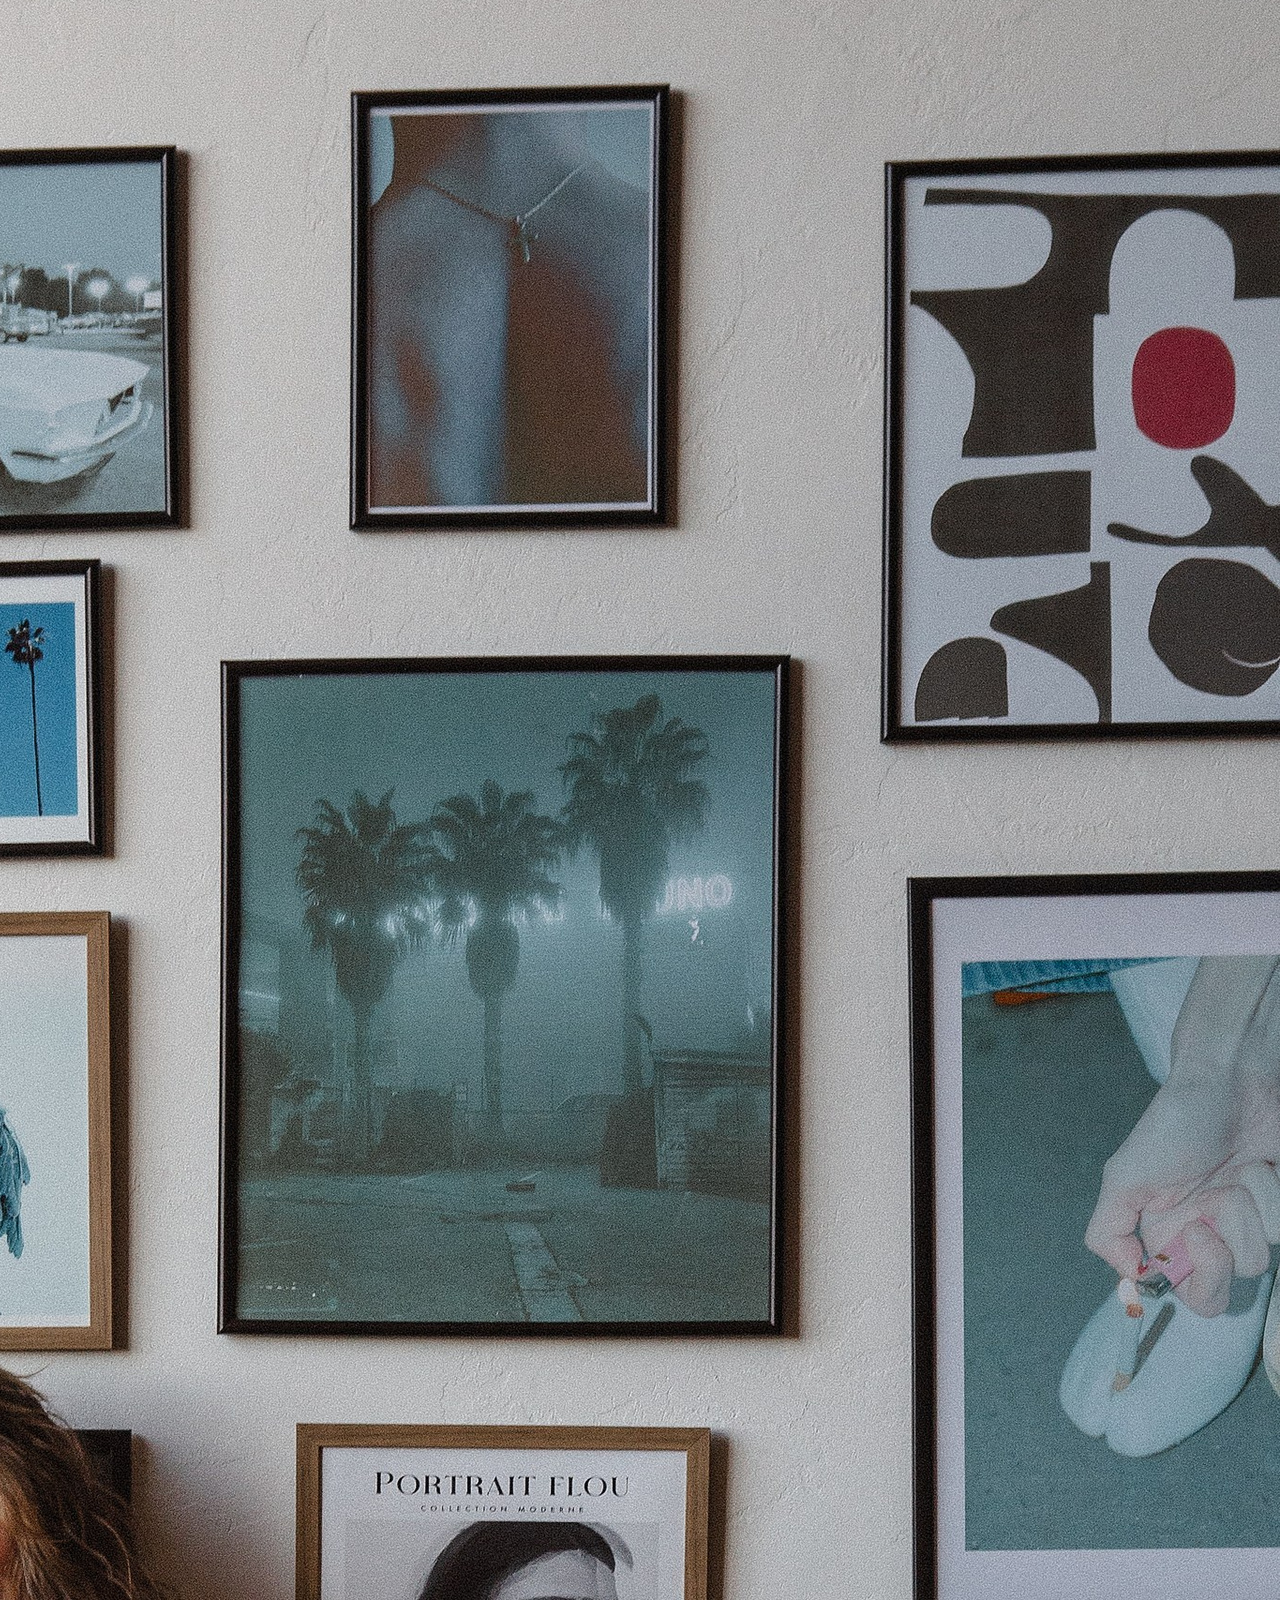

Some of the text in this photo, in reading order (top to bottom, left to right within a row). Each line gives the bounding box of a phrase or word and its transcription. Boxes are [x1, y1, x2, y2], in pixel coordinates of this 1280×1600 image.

[375, 1471, 629, 1498] PORTRAIT FLOU
[420, 1505, 585, 1514] COLLECTION MODERNE
